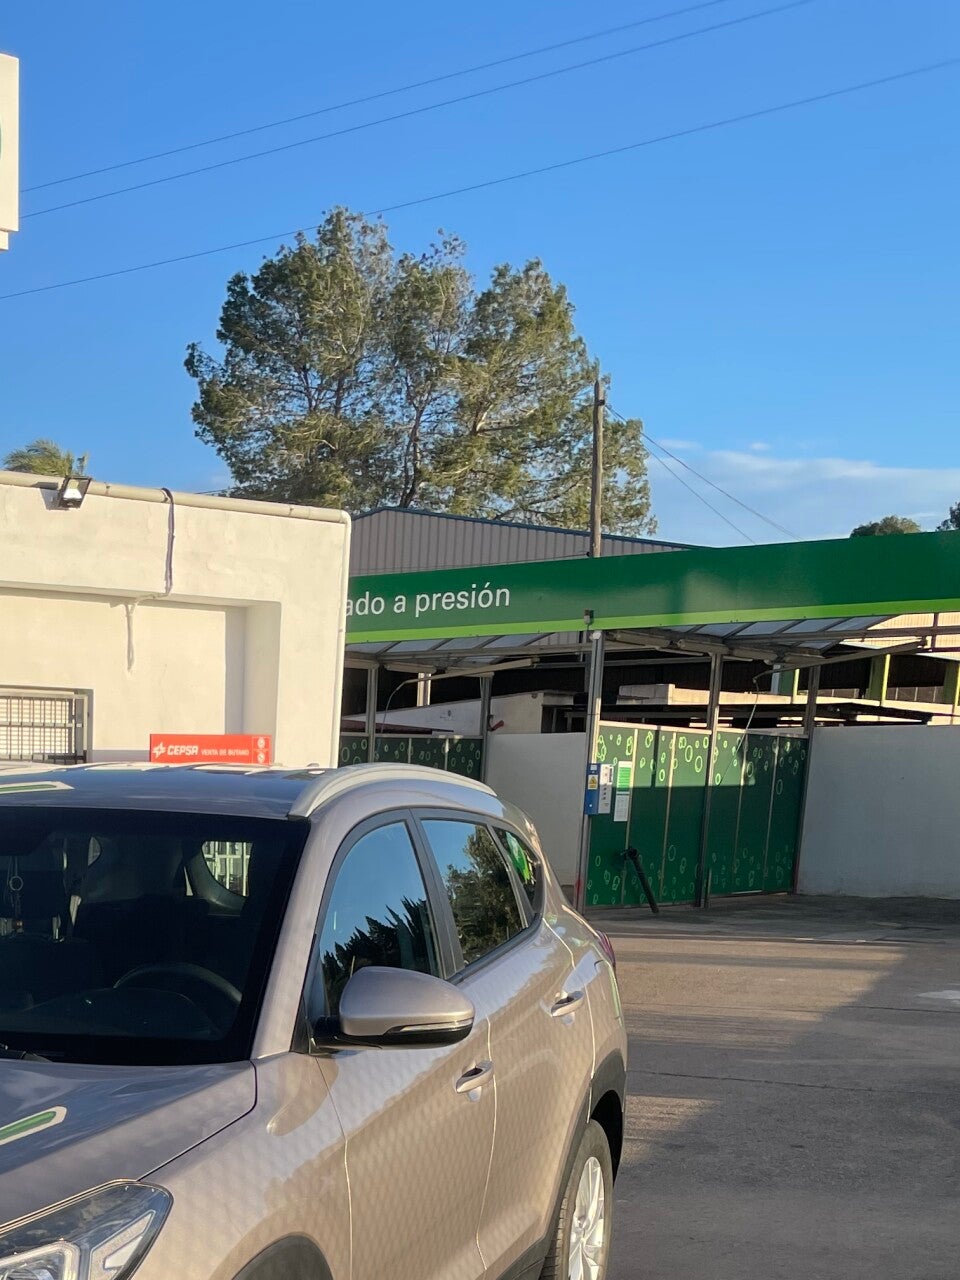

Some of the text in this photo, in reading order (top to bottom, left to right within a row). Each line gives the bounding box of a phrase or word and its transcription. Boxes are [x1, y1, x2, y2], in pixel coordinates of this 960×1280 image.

[393, 595, 407, 613] a
[415, 582, 510, 617] presión
[167, 745, 199, 756] CEPSA
